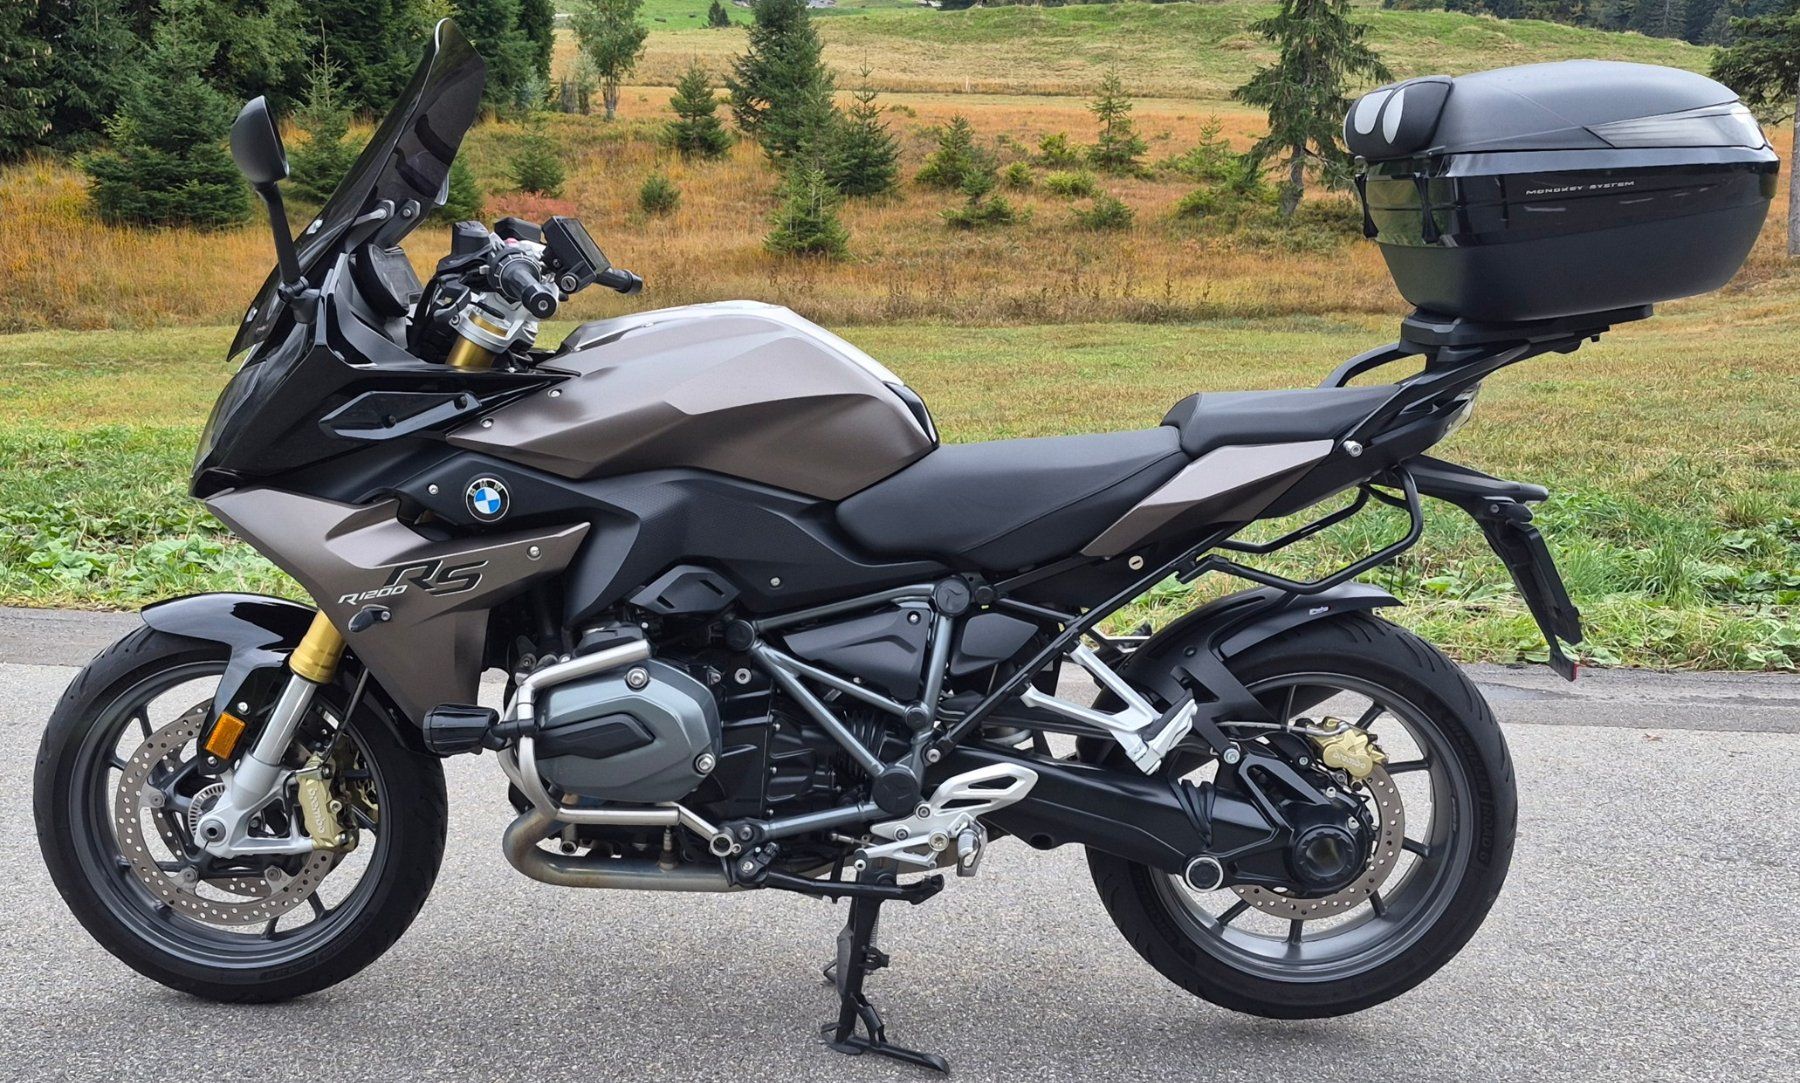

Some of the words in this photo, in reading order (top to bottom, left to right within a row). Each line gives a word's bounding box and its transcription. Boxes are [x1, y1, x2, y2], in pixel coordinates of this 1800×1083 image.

[1526, 186, 1583, 195] MONOKEY
[1589, 181, 1635, 190] SYSTEM
[469, 480, 503, 497] BMW
[338, 585, 408, 605] R1200
[384, 560, 489, 597] RS
